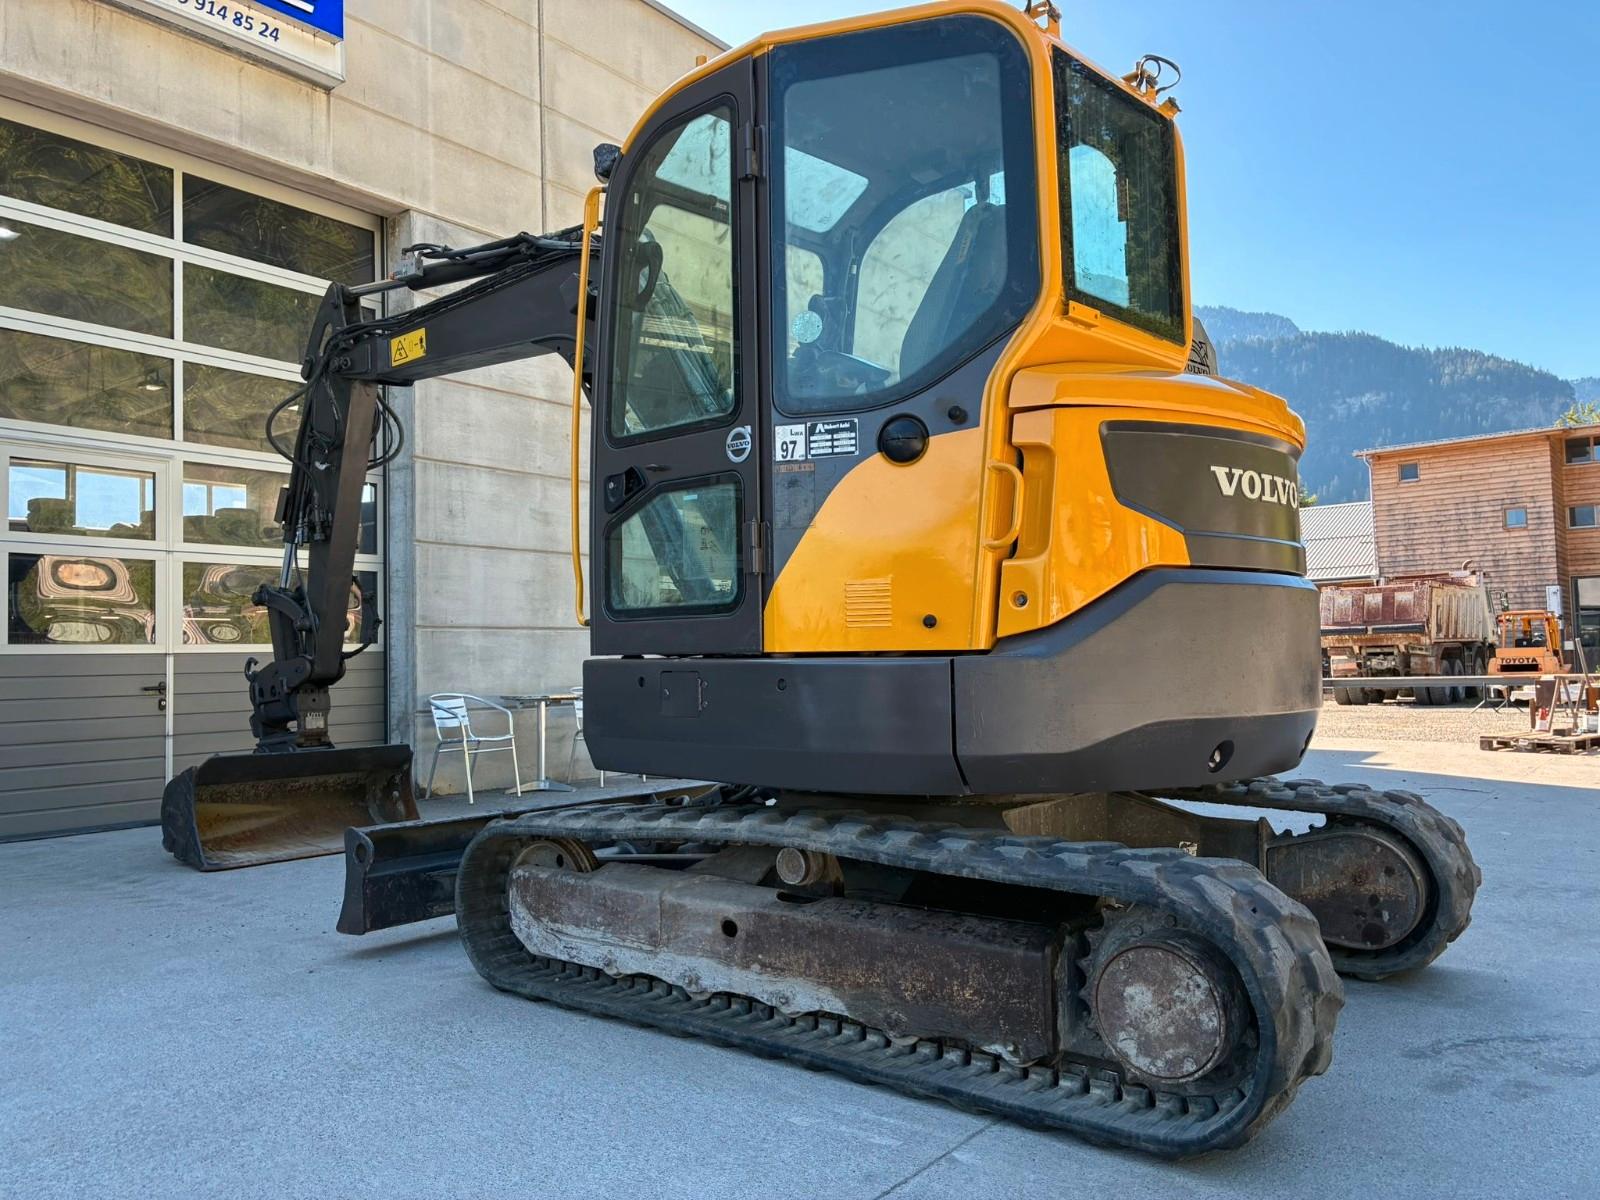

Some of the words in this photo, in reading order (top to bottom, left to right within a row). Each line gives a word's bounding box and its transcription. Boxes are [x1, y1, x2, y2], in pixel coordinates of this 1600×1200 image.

[194, 0, 228, 20] 914
[233, 11, 254, 31] 85
[258, 22, 280, 42] 24
[727, 440, 750, 449] VOLVO
[780, 440, 798, 459] 97
[1211, 465, 1298, 509] VOLVO
